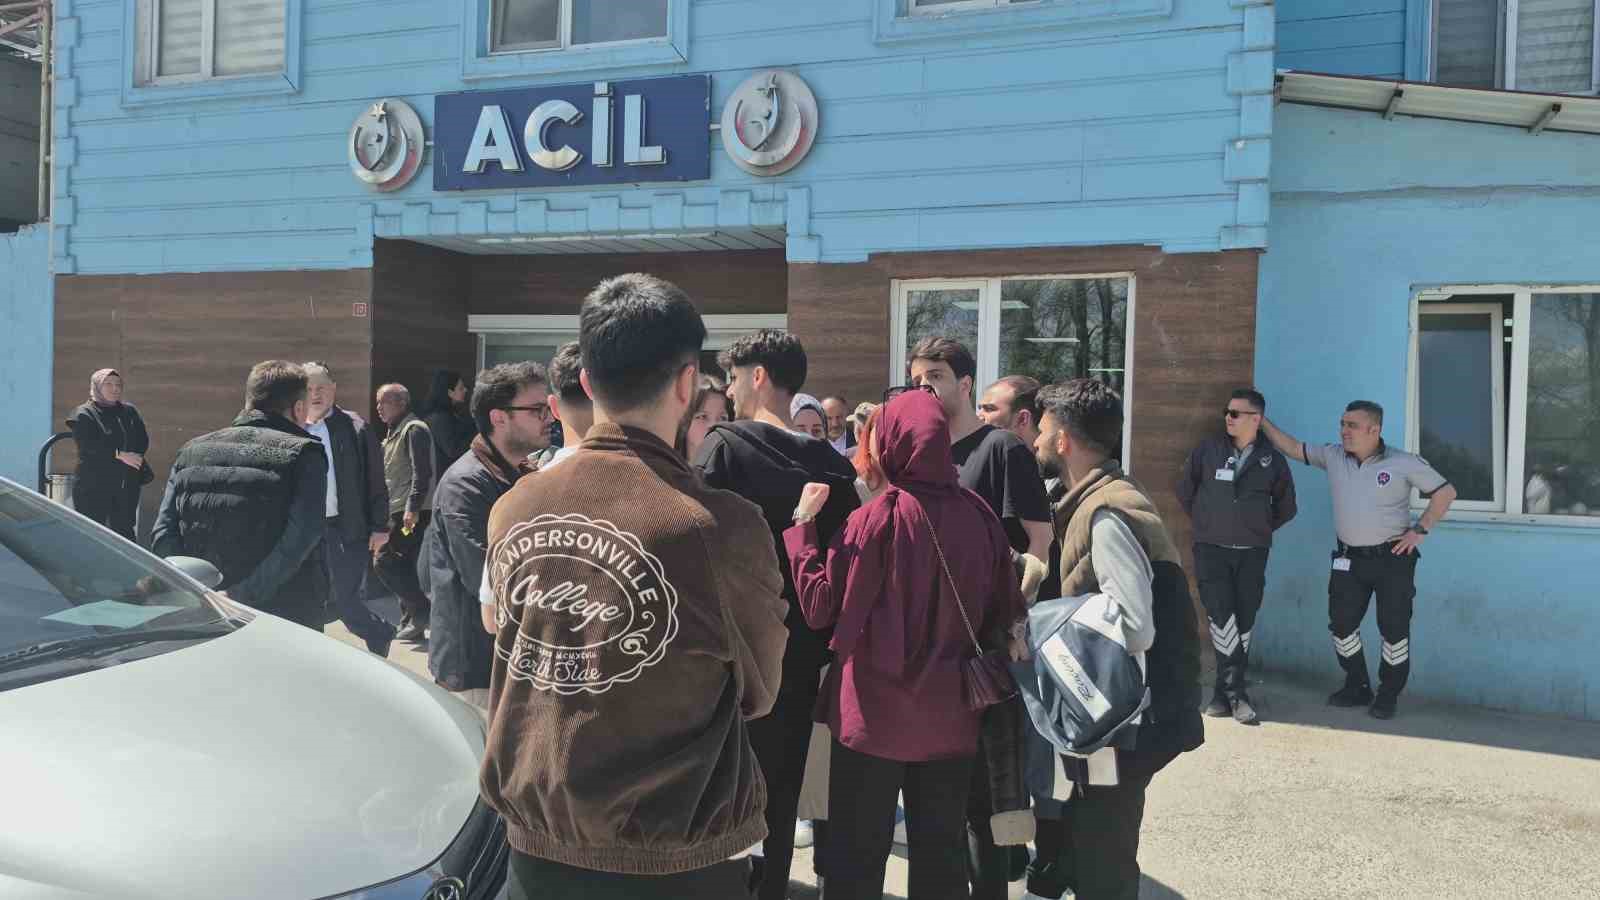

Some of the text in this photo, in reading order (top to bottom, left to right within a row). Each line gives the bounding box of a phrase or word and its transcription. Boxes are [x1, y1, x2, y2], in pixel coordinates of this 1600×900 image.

[462, 81, 667, 173] ACİL
[499, 529, 659, 605] ANDERSONVILLE
[511, 574, 625, 632] College
[555, 658, 602, 681] Side
